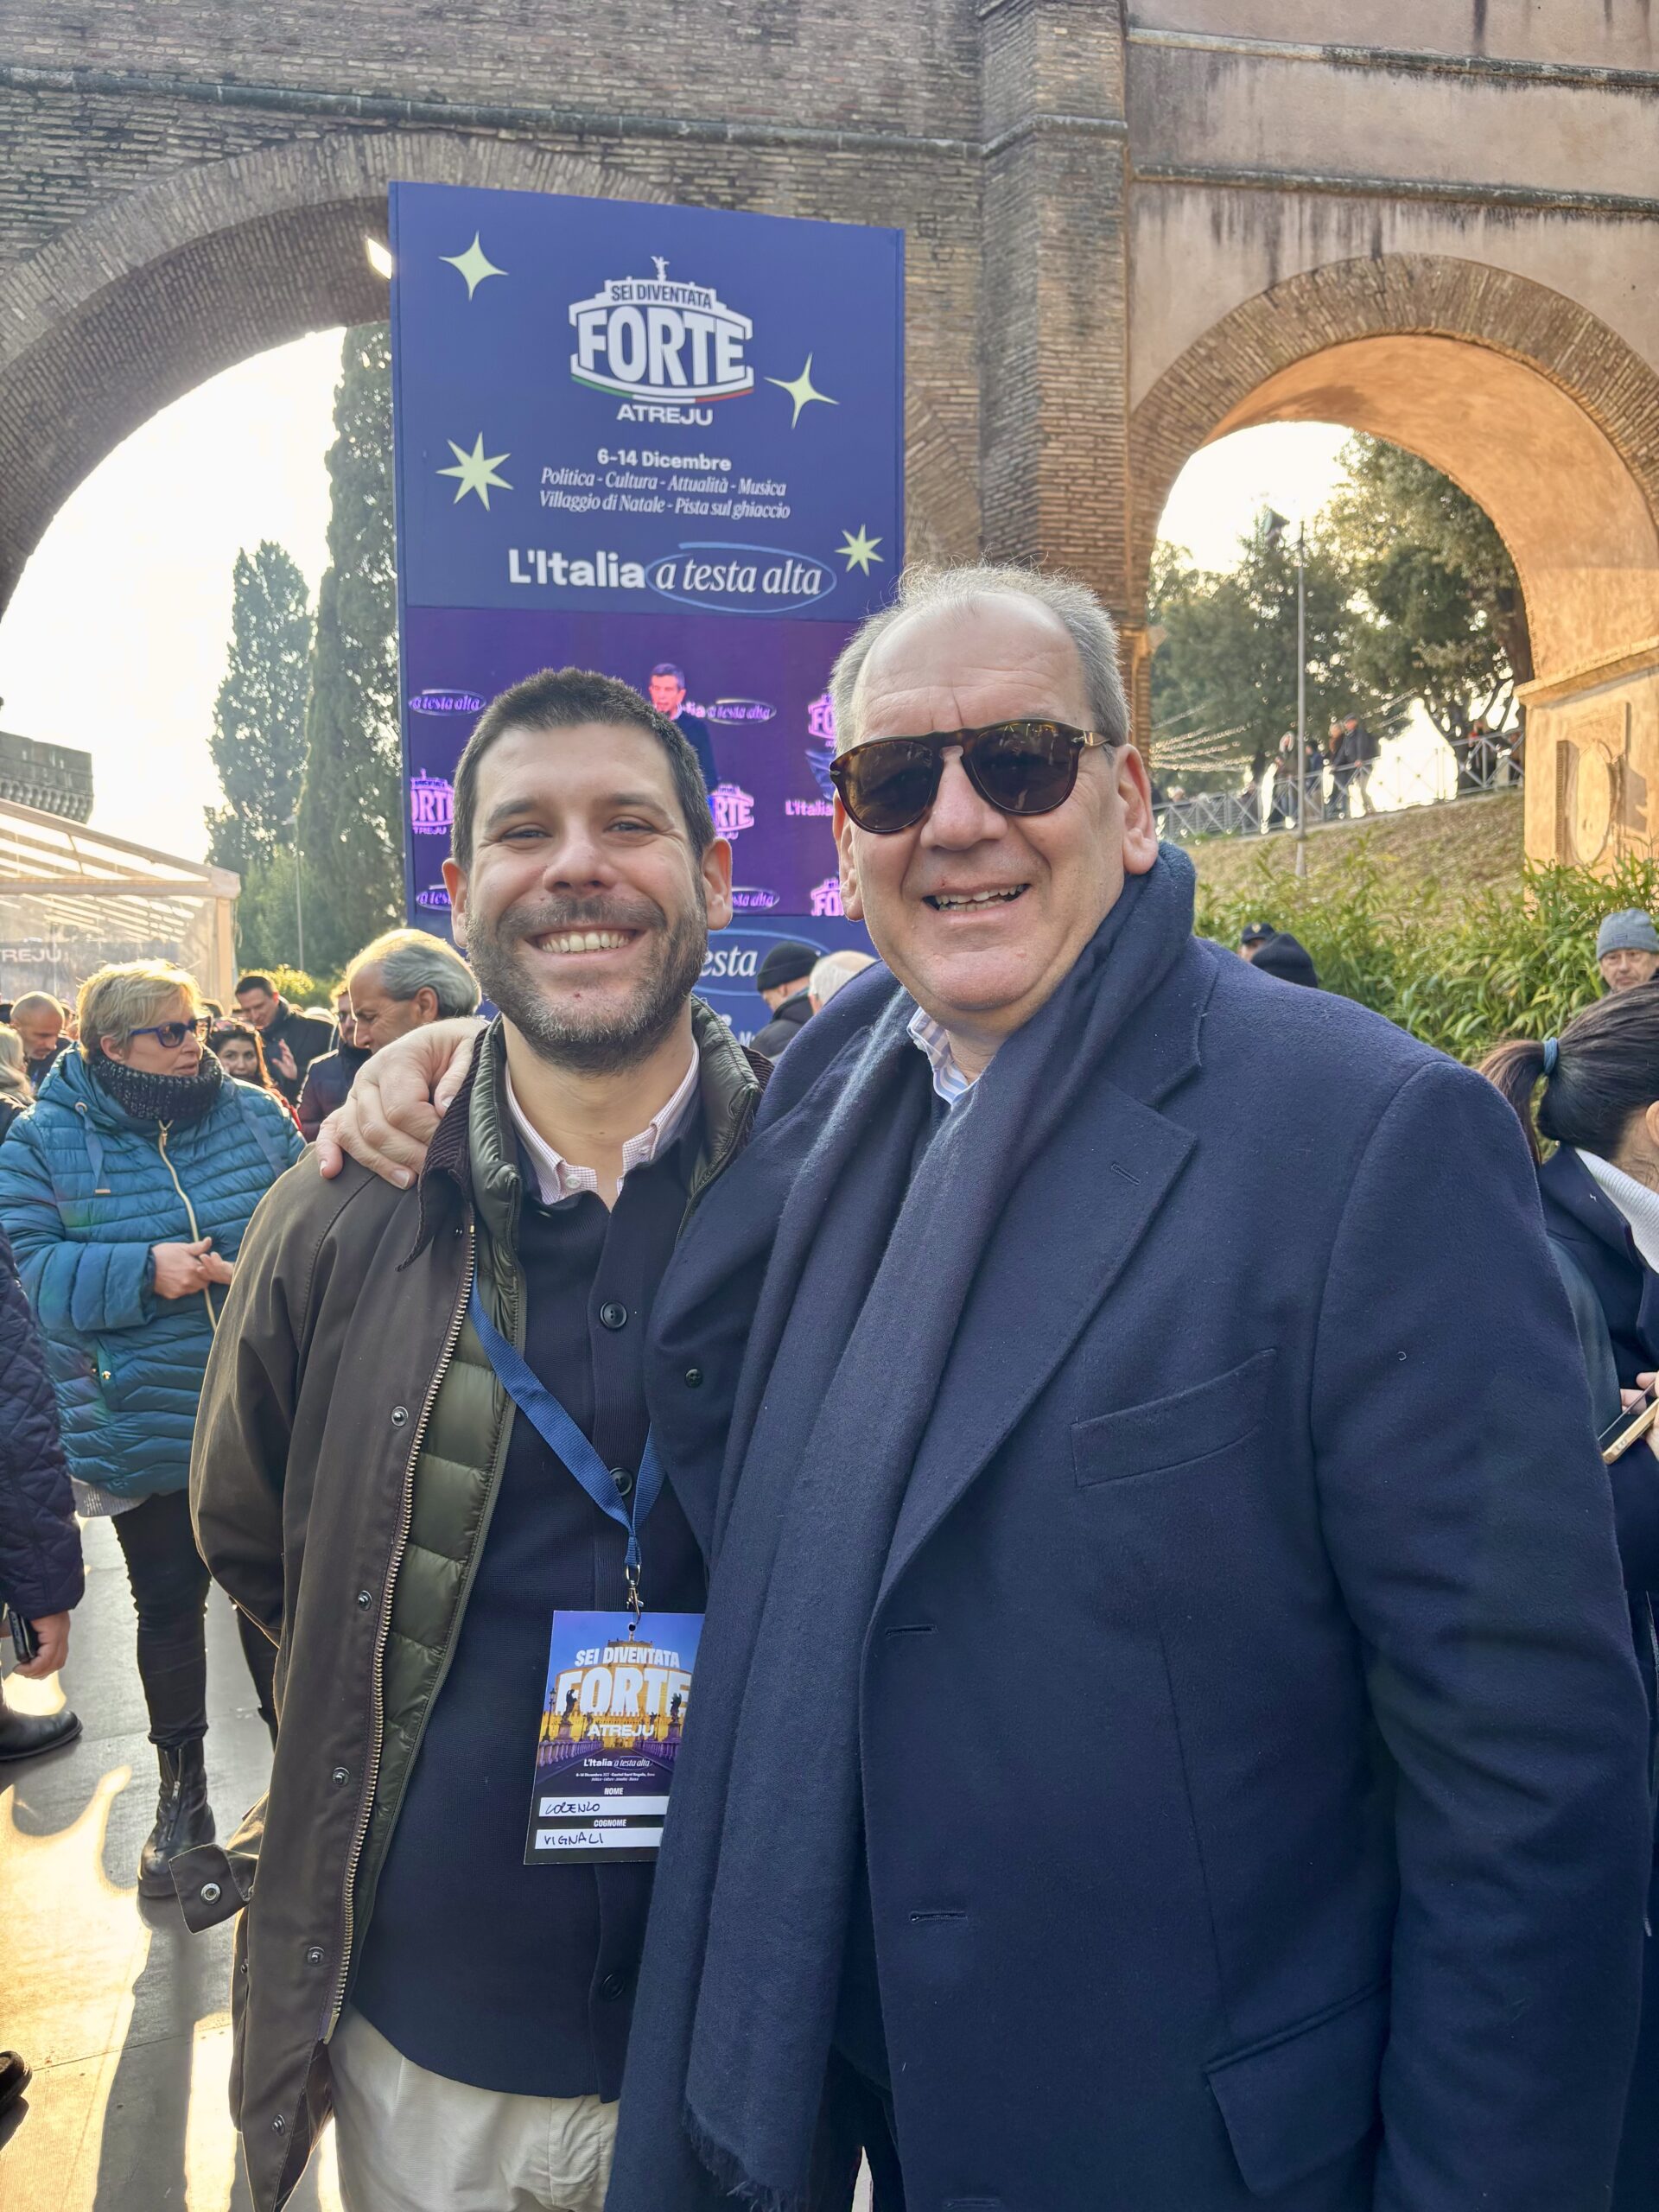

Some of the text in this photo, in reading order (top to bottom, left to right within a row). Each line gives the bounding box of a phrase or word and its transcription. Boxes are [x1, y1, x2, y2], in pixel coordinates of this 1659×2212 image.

[612, 283, 712, 310] SEI DIVENTATA
[577, 305, 747, 386] FORTE
[616, 404, 714, 426] ATREJU
[597, 448, 733, 472] 6-14 Dicembre
[541, 467, 595, 486] Politica
[606, 471, 658, 490] Cultura
[667, 474, 728, 493] Attualità
[738, 478, 787, 496] Musica
[540, 490, 601, 512] Villaggio
[601, 493, 618, 512] di
[618, 493, 665, 513] Natale
[675, 497, 709, 515] Pista
[709, 499, 733, 517] sul
[731, 499, 791, 520] ghiaccio
[508, 549, 822, 595] L'Italia a testa alta
[1, 948, 62, 963] REJU
[699, 945, 759, 977] esta
[575, 1646, 681, 1669] SEI DIVENTATA
[555, 1667, 691, 1718] FORTE
[587, 1724, 655, 1737] ATREJU
[583, 1758, 613, 1767] L'Italia
[636, 1758, 650, 1767] alta
[594, 1819, 627, 1827] COGNOME
[544, 1832, 604, 1846] VIGNALI
